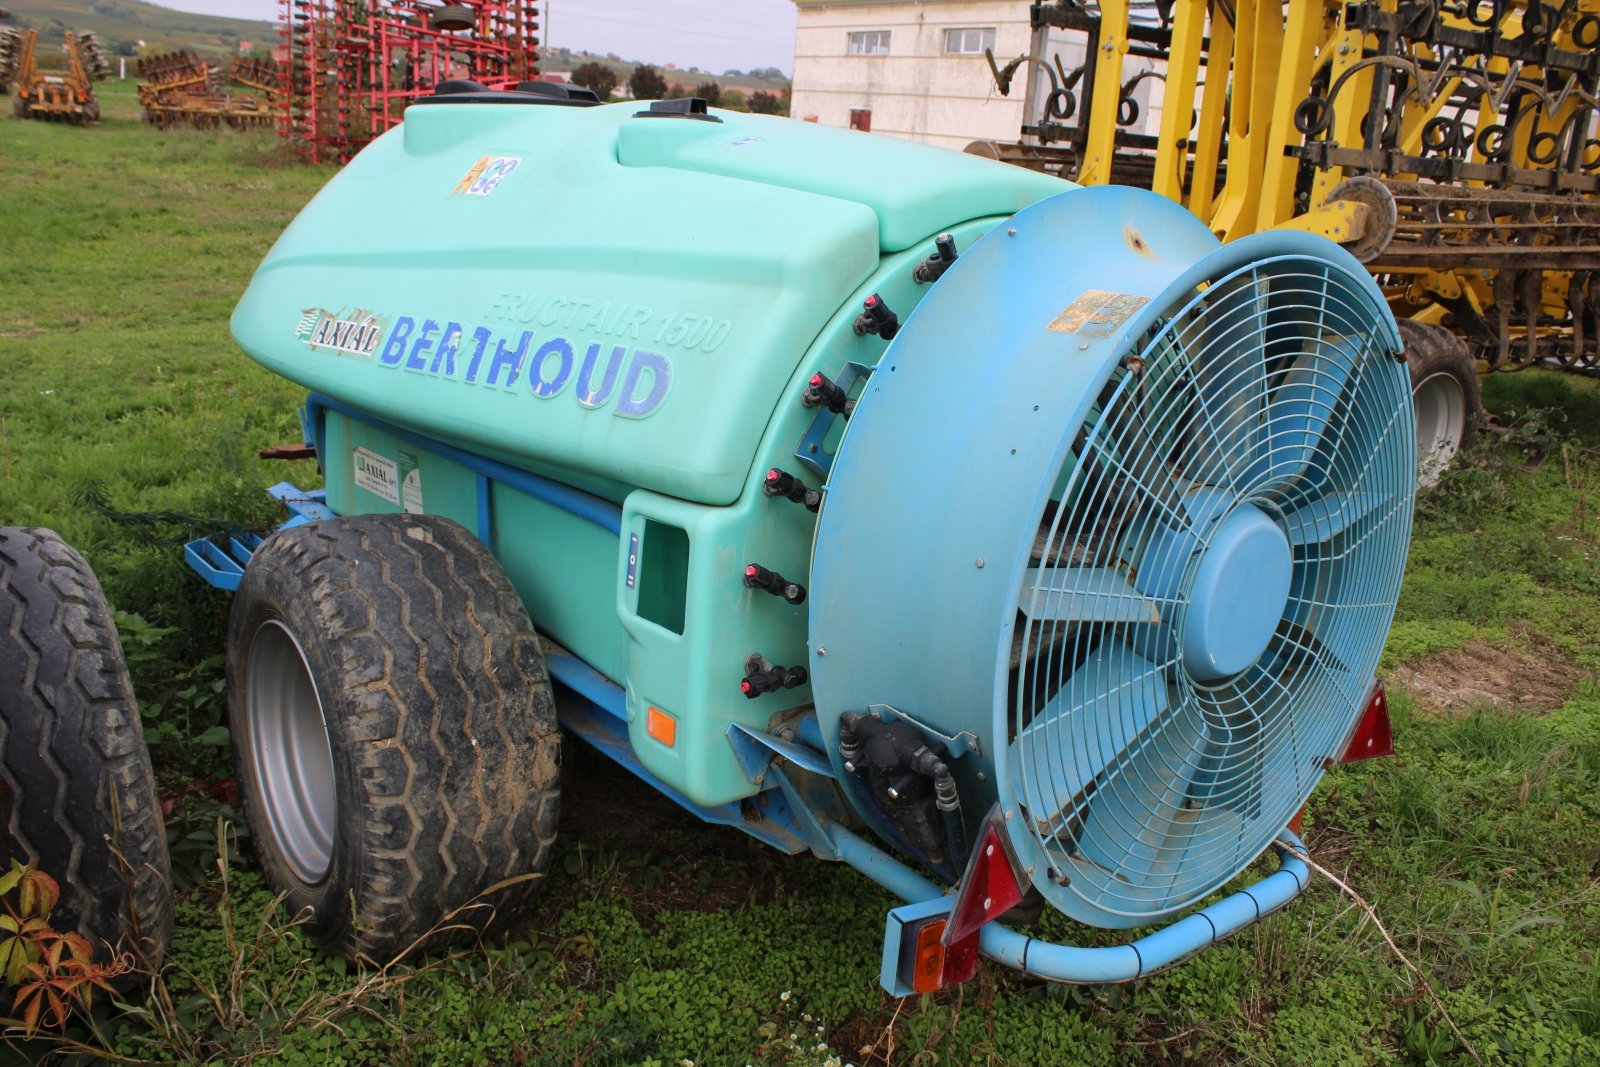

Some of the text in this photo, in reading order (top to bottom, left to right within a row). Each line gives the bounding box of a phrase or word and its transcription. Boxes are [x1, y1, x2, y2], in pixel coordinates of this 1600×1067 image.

[314, 316, 379, 354] AXIÁL
[483, 290, 732, 353] FRUCTAIR 1500
[379, 315, 673, 419] BERTHOUD
[365, 463, 387, 483] AXIÁL
